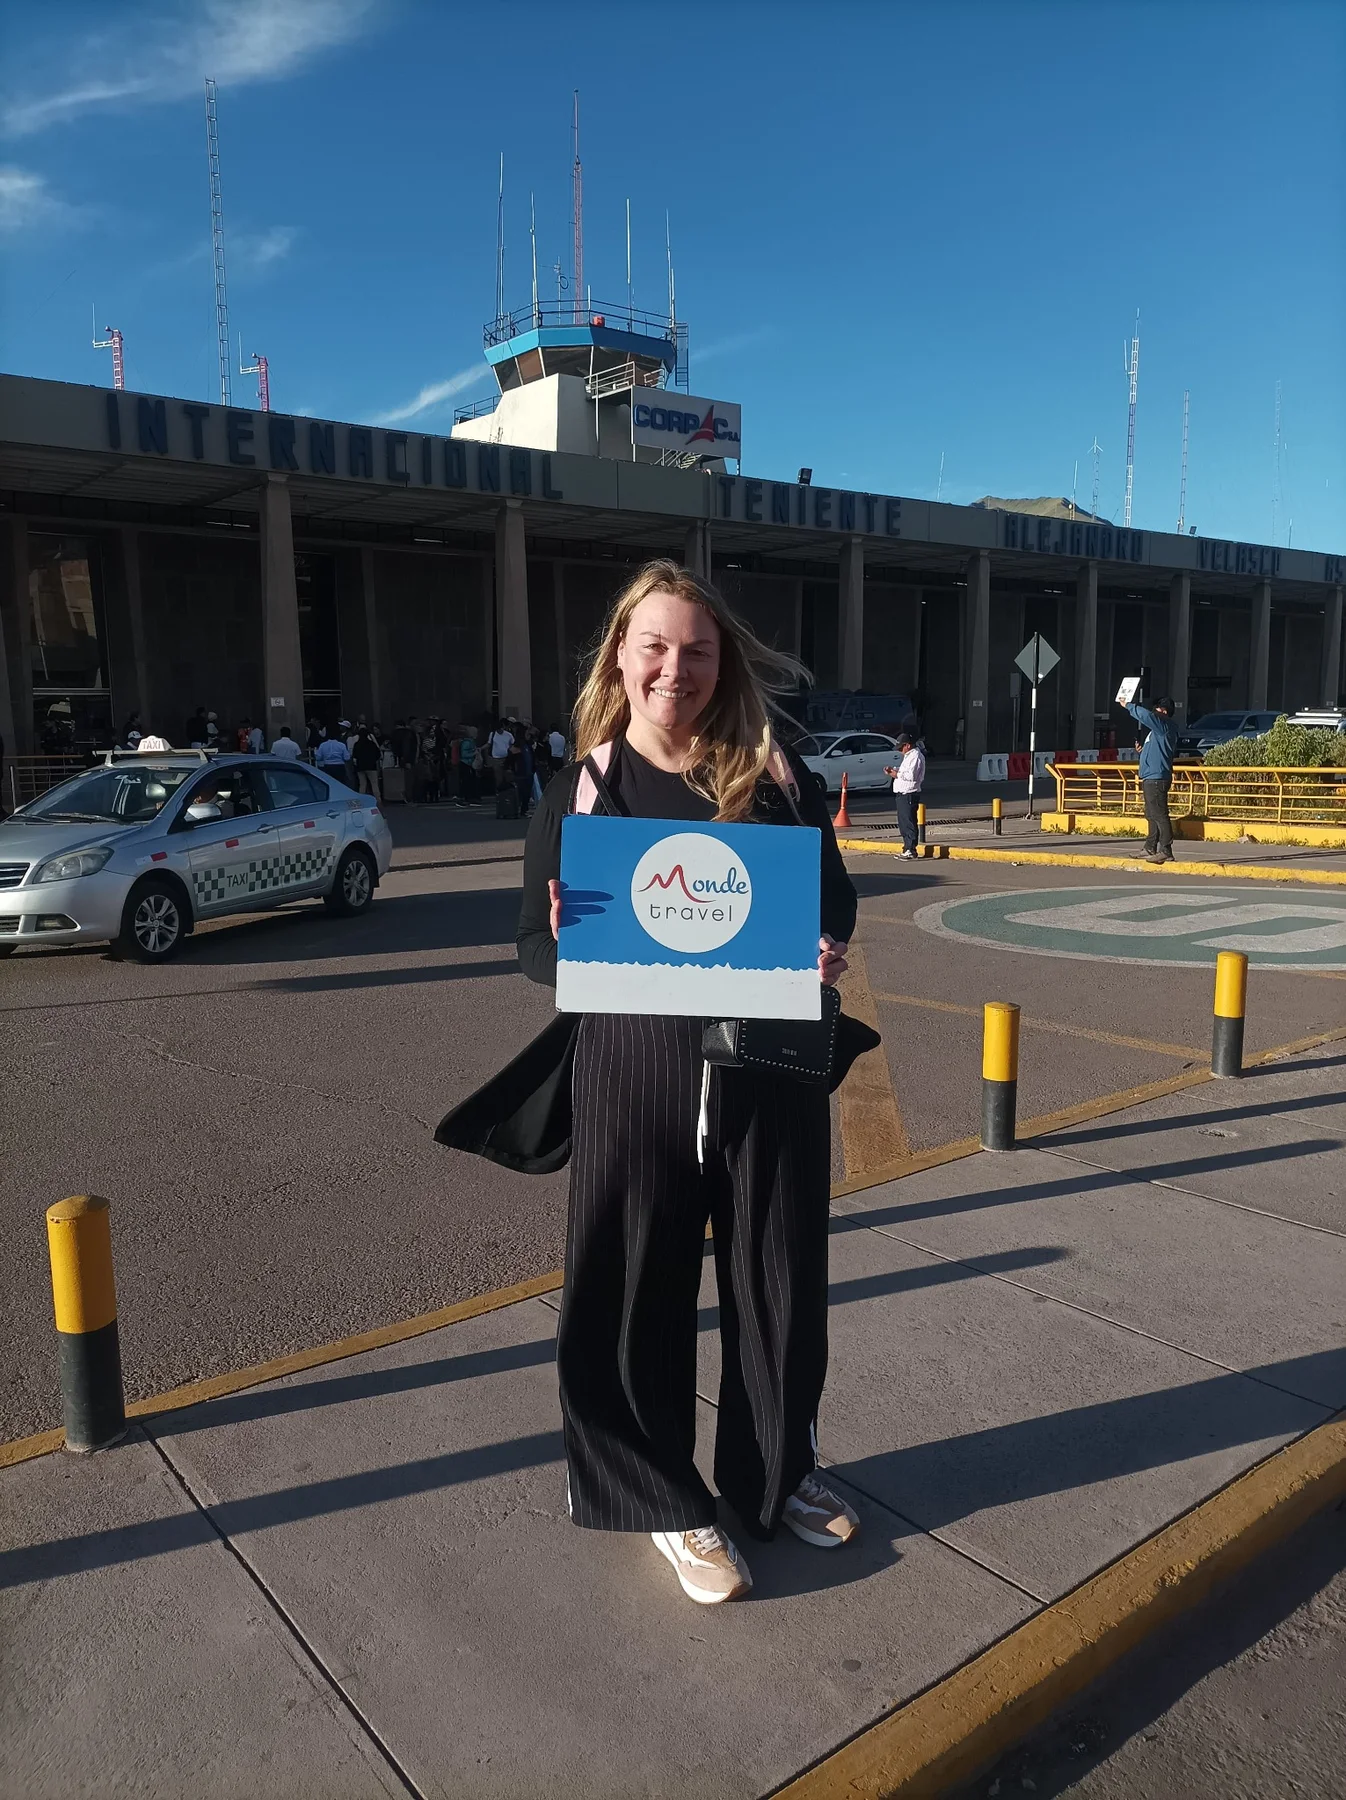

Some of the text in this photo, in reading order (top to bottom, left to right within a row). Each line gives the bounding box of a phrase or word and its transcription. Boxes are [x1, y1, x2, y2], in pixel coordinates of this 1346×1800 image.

[105, 392, 563, 500] INTERNACIONAL
[718, 475, 901, 536] TENIENTE
[1004, 512, 1144, 562] ALEJANDRO
[142, 740, 161, 750] TAXI
[226, 872, 249, 888] TAXI
[635, 864, 750, 903] Monde
[650, 904, 732, 922] travel
